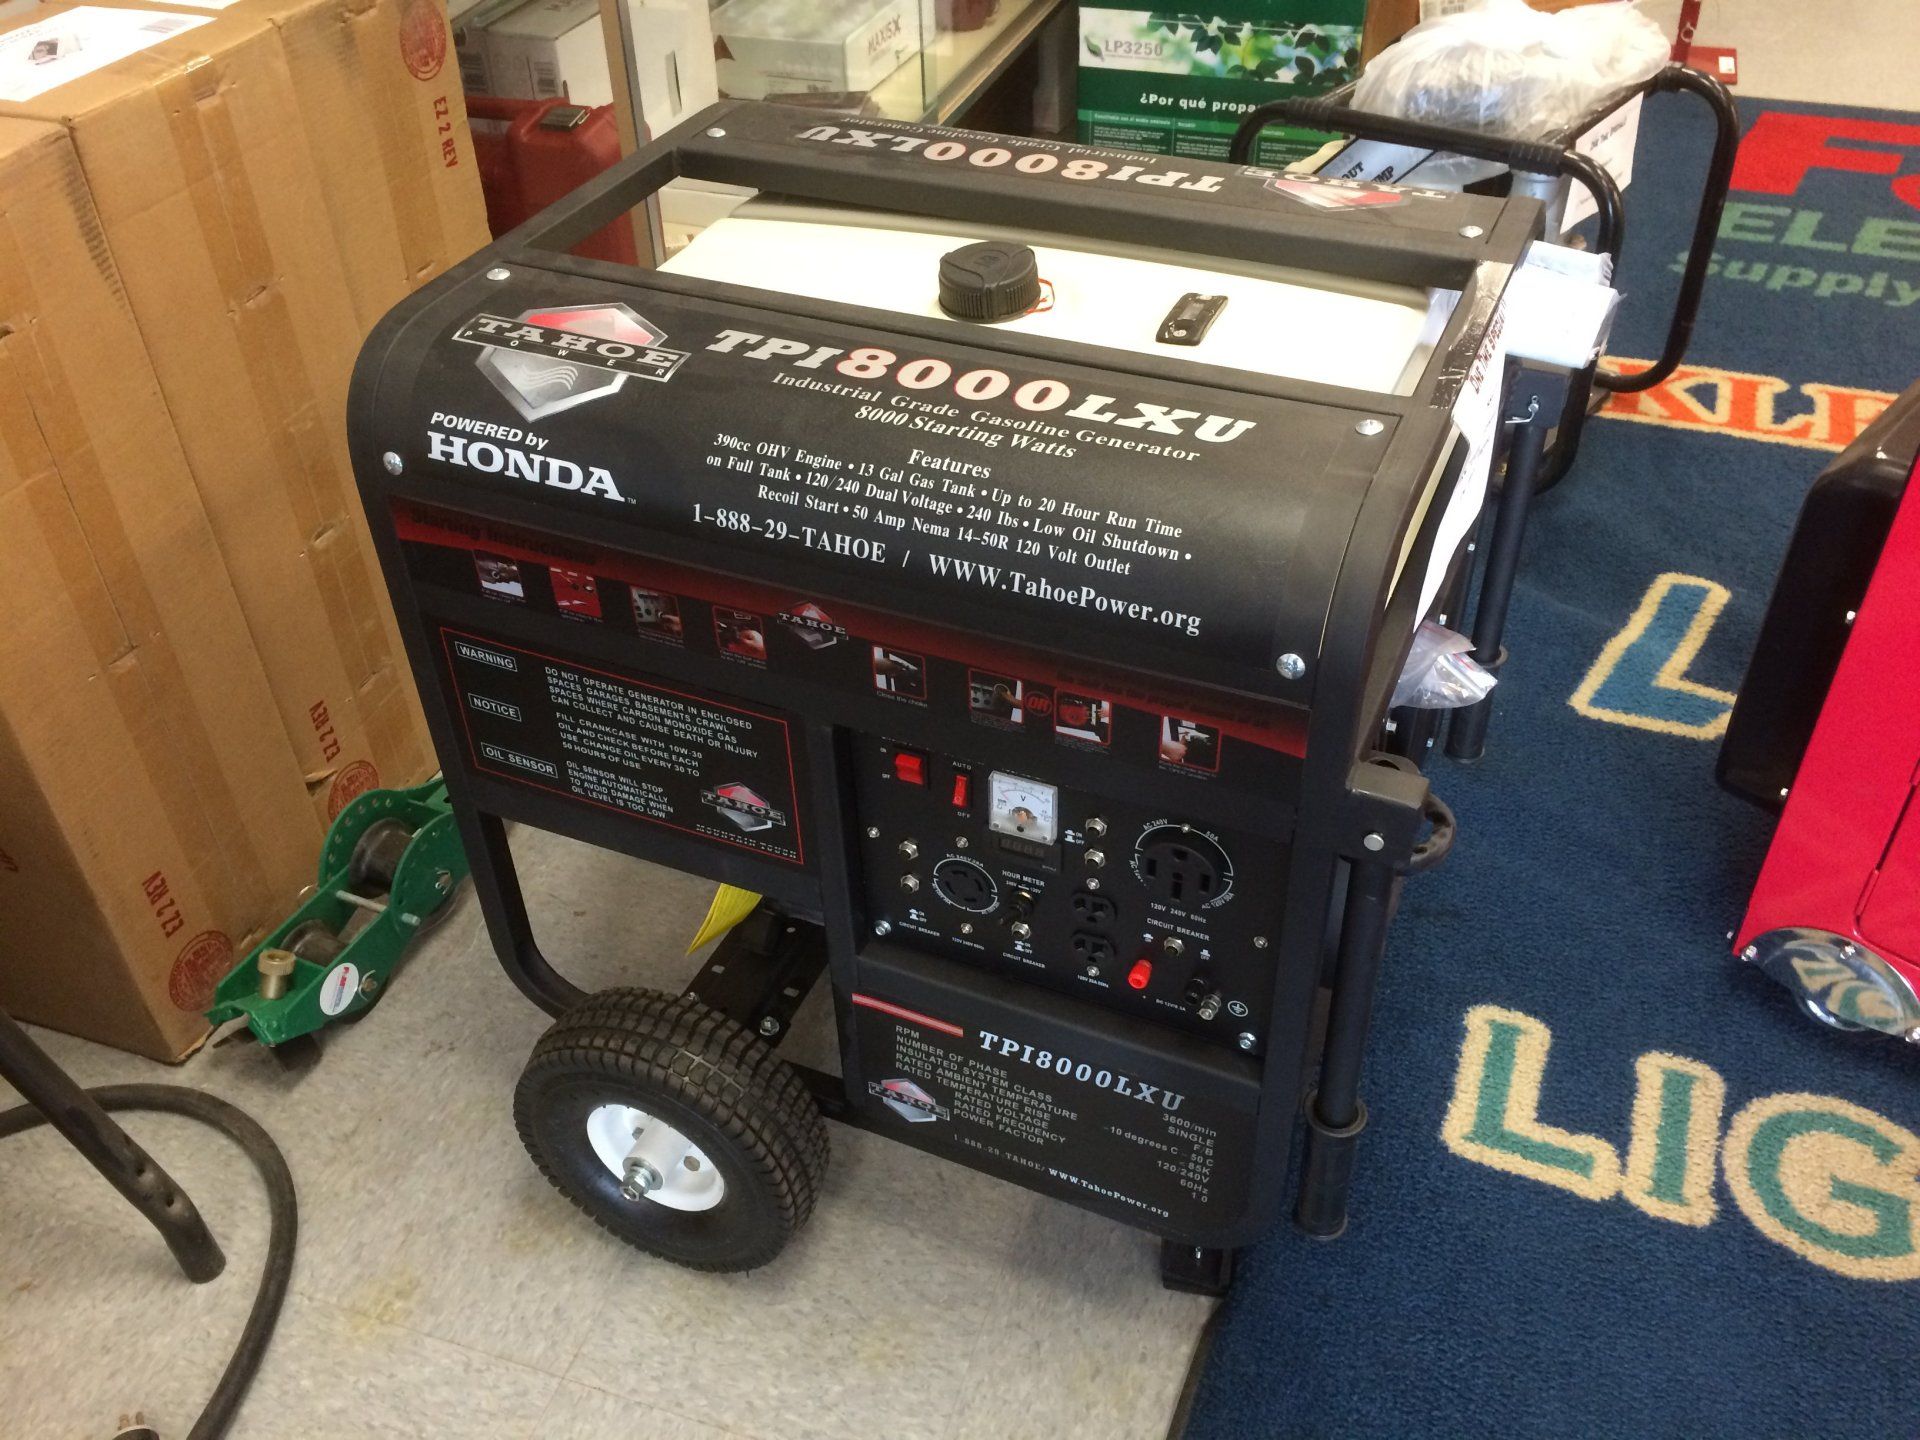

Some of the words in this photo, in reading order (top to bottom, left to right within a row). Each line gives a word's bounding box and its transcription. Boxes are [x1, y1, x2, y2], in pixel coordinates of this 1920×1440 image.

[1104, 40, 1163, 56] LP3250
[433, 96, 449, 121] EZ
[1140, 92, 1174, 106] ¿Por
[1179, 97, 1206, 109] qué
[1212, 103, 1257, 115] propa
[438, 122, 451, 135] 2
[442, 138, 459, 168] REV
[795, 124, 1226, 193] TPI8000LXU
[1243, 168, 1448, 199] TAHOE
[1667, 250, 1920, 306] Supply
[478, 318, 678, 369] TAHOE
[703, 329, 1258, 443] TPI8000LXU
[430, 411, 522, 443] POWERED
[525, 432, 549, 451] by
[771, 372, 883, 403] Industrial
[890, 395, 960, 418] Grade
[970, 410, 1070, 439] Gasoline
[1075, 429, 1201, 463] Generator
[854, 405, 909, 427] 8000
[908, 415, 1005, 449] Starting
[1009, 433, 1078, 459] Watts
[427, 430, 626, 503] HONDA
[906, 448, 992, 480] Features
[713, 433, 751, 452] 390cc
[756, 441, 791, 460] OHV
[795, 449, 842, 471] Engine
[857, 462, 874, 477] 13
[879, 466, 902, 483] Gal
[909, 472, 935, 489] Gas
[942, 478, 976, 498] Tank
[991, 488, 1012, 507] Up
[1018, 492, 1032, 508] to
[1038, 497, 1056, 514] 20
[1060, 502, 1100, 521] Hour
[1105, 510, 1137, 530] Run
[1145, 517, 1183, 539] Time
[706, 454, 721, 467] on
[727, 455, 754, 474] Full
[759, 461, 791, 482] Tank
[805, 471, 860, 495] 120/240
[865, 483, 898, 504] Dual
[901, 490, 953, 516] Voltage
[966, 505, 992, 522] 240
[1033, 518, 1066, 537] Low
[1072, 526, 1096, 544] Oil
[1102, 532, 1179, 561] Shutdown
[757, 484, 800, 507] Recoil
[804, 494, 840, 514] Start
[852, 505, 869, 520] 50
[873, 509, 906, 531] Amp
[911, 516, 950, 538] Nema
[957, 526, 1009, 550] 14-50R
[1016, 538, 1040, 556] 120
[1047, 544, 1078, 565] Volt
[1084, 552, 1132, 576] Outlet
[692, 503, 887, 564] 1-888-29-TAHOE
[928, 553, 1202, 637] WWW.TahoePower.org
[778, 612, 847, 635] TAHOE
[459, 645, 514, 669] WARNING
[308, 699, 330, 733] REV
[473, 698, 518, 718] NOTICE
[547, 676, 582, 692] SPACES
[635, 700, 691, 722] BASEMENTS
[549, 685, 583, 701] SPACES
[587, 696, 618, 710] WHERE
[622, 706, 661, 724] CARBON
[664, 716, 714, 737] MONOXIDE
[717, 730, 737, 744] GAS
[561, 671, 579, 683] NOT
[583, 677, 624, 695] OPERATE
[628, 689, 684, 712] GENERATOR
[701, 709, 753, 730] ENCLOSED
[320, 725, 335, 739] 2
[551, 695, 570, 706] CAN
[573, 702, 613, 718] COLLECT
[617, 713, 635, 725] AND
[639, 719, 670, 735] CAUSE
[673, 728, 704, 744] DEATH
[725, 742, 758, 760] INJURY
[556, 711, 575, 723] FILL
[579, 718, 637, 741] CRANKCASE
[640, 736, 665, 749] WITH
[558, 722, 573, 732] OIL
[576, 727, 596, 739] AND
[597, 733, 630, 749] CHECK
[632, 743, 669, 760] BEFORE
[672, 754, 699, 768] EACH
[323, 740, 341, 763] EZ
[486, 747, 505, 760] OIL
[508, 754, 554, 775] SENSOR
[560, 731, 579, 743] USE
[583, 738, 622, 754] CHANGE
[641, 754, 672, 770] EVERY
[574, 745, 606, 760] HOURS
[623, 758, 642, 770] USE
[953, 760, 972, 770] AUTO
[568, 768, 599, 783] ENGINE
[601, 776, 668, 804] AUTOMATICALLY
[582, 765, 616, 781] SENSOR
[587, 790, 613, 803] LEVEL
[611, 788, 647, 805] DAMAGE
[649, 800, 674, 814] WHEN
[141, 870, 170, 903] REV
[1002, 869, 1021, 881] HOUR
[1022, 875, 1046, 888] METER
[156, 897, 176, 919] 2
[160, 910, 185, 939] EZ
[1146, 917, 1174, 931] CIRCUIT
[1176, 926, 1210, 942] BREAKER
[895, 1024, 920, 1040] RPM
[895, 1035, 944, 1058] NUMBER
[949, 1052, 964, 1064] OF
[968, 1059, 1008, 1078] PHASE
[895, 1044, 958, 1072] INSULATED
[962, 1066, 1009, 1088] SYSTEM
[1014, 1081, 1053, 1103] CLASS
[979, 1030, 1185, 1111] TPI8000LXU
[895, 1053, 932, 1071] RATED
[936, 1066, 987, 1090] AMBIENT
[992, 1085, 1078, 1121] TEMPERATURE
[895, 1061, 931, 1080] RATED
[935, 1075, 1020, 1111] TEMPERATURE
[1023, 1105, 1051, 1121] RISE
[953, 1108, 994, 1128] POWER
[999, 1124, 1045, 1145] FACTOR
[954, 1091, 992, 1113] RATED
[996, 1106, 1050, 1130] VOLTAGE
[954, 1100, 991, 1119] RATED
[995, 1114, 1067, 1144] FREQUENCY
[1163, 1113, 1217, 1138] 3600/min
[1124, 1130, 1168, 1152] degrees
[1168, 1125, 1215, 1148] SINGLE
[1048, 1167, 1170, 1218] WWW.TahoePower.org
[1180, 1178, 1209, 1195] 60Hz
